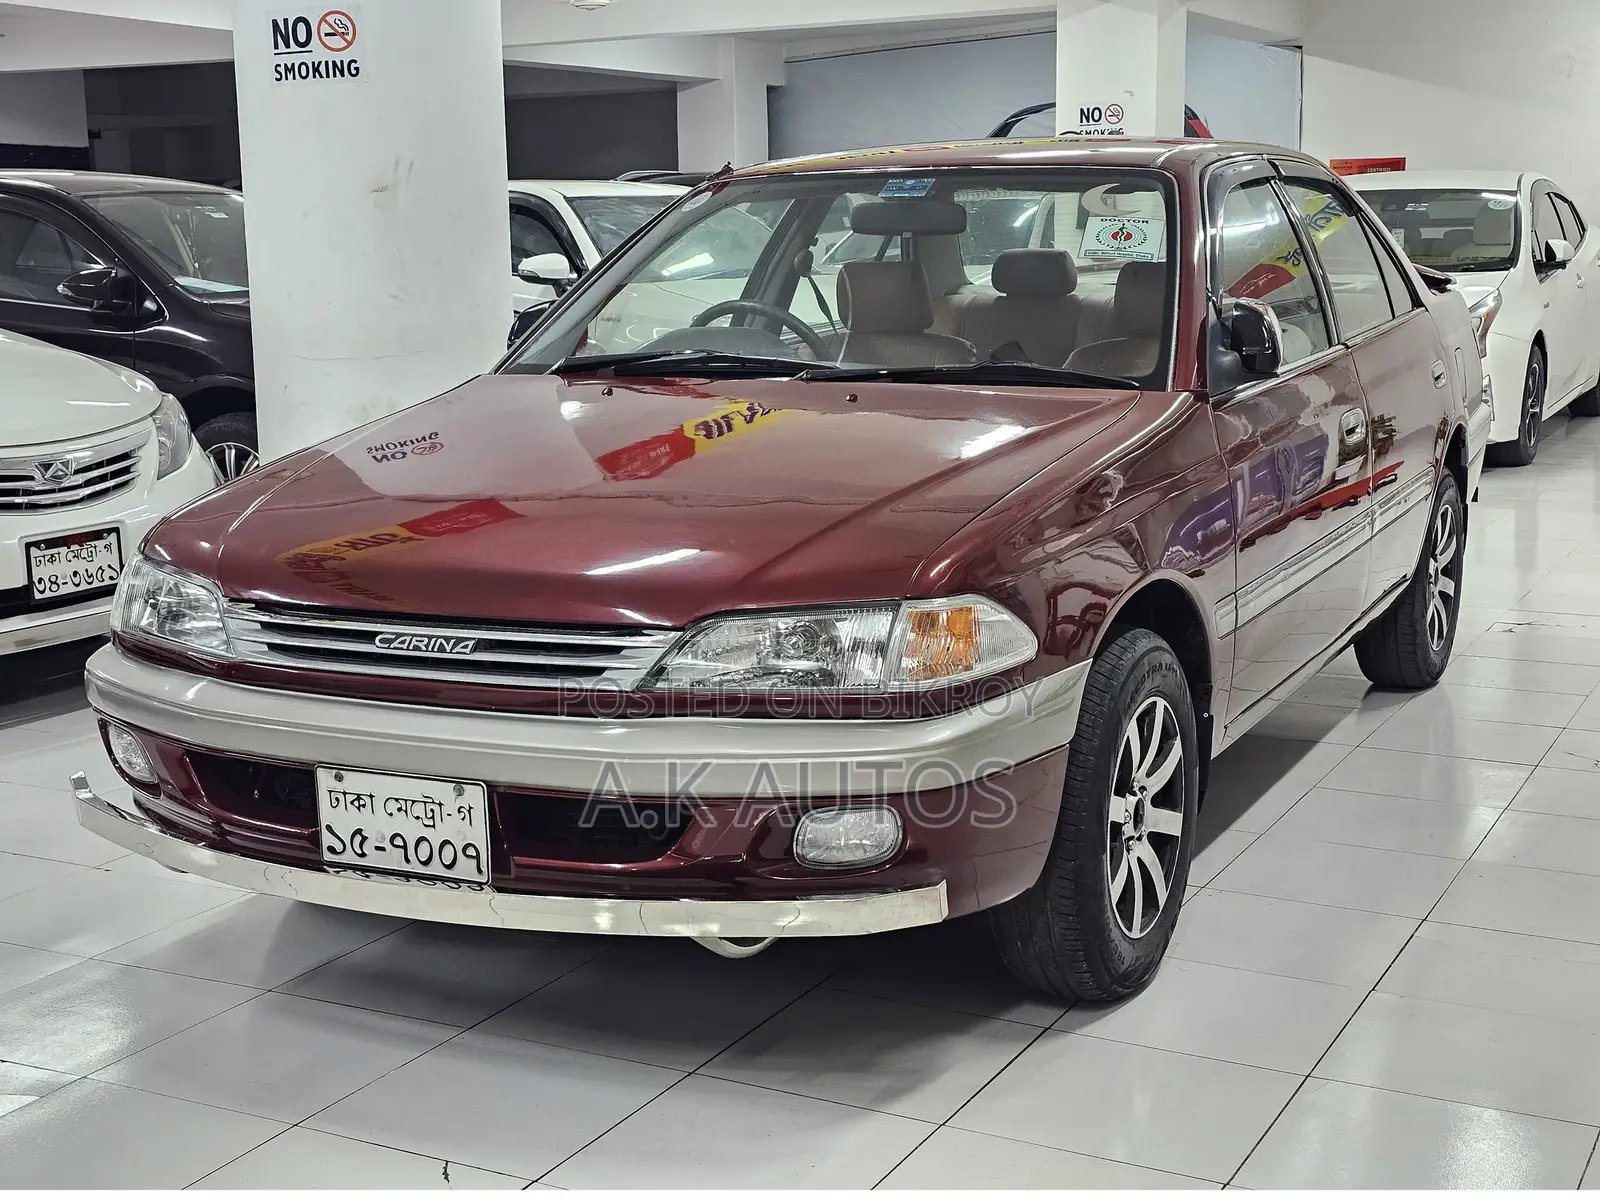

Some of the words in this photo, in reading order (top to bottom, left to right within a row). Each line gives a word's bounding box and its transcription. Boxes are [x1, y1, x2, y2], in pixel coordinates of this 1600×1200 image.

[272, 16, 313, 50] NO
[274, 59, 360, 82] SMOKING
[1079, 106, 1103, 124] NO
[33, 551, 62, 568] ঢাকা
[33, 563, 120, 595] ৩৪-৩৬৫১
[374, 633, 478, 656] CARINA
[326, 789, 376, 816] ঢাকা
[324, 823, 485, 876] ১৫-৭০০৭
